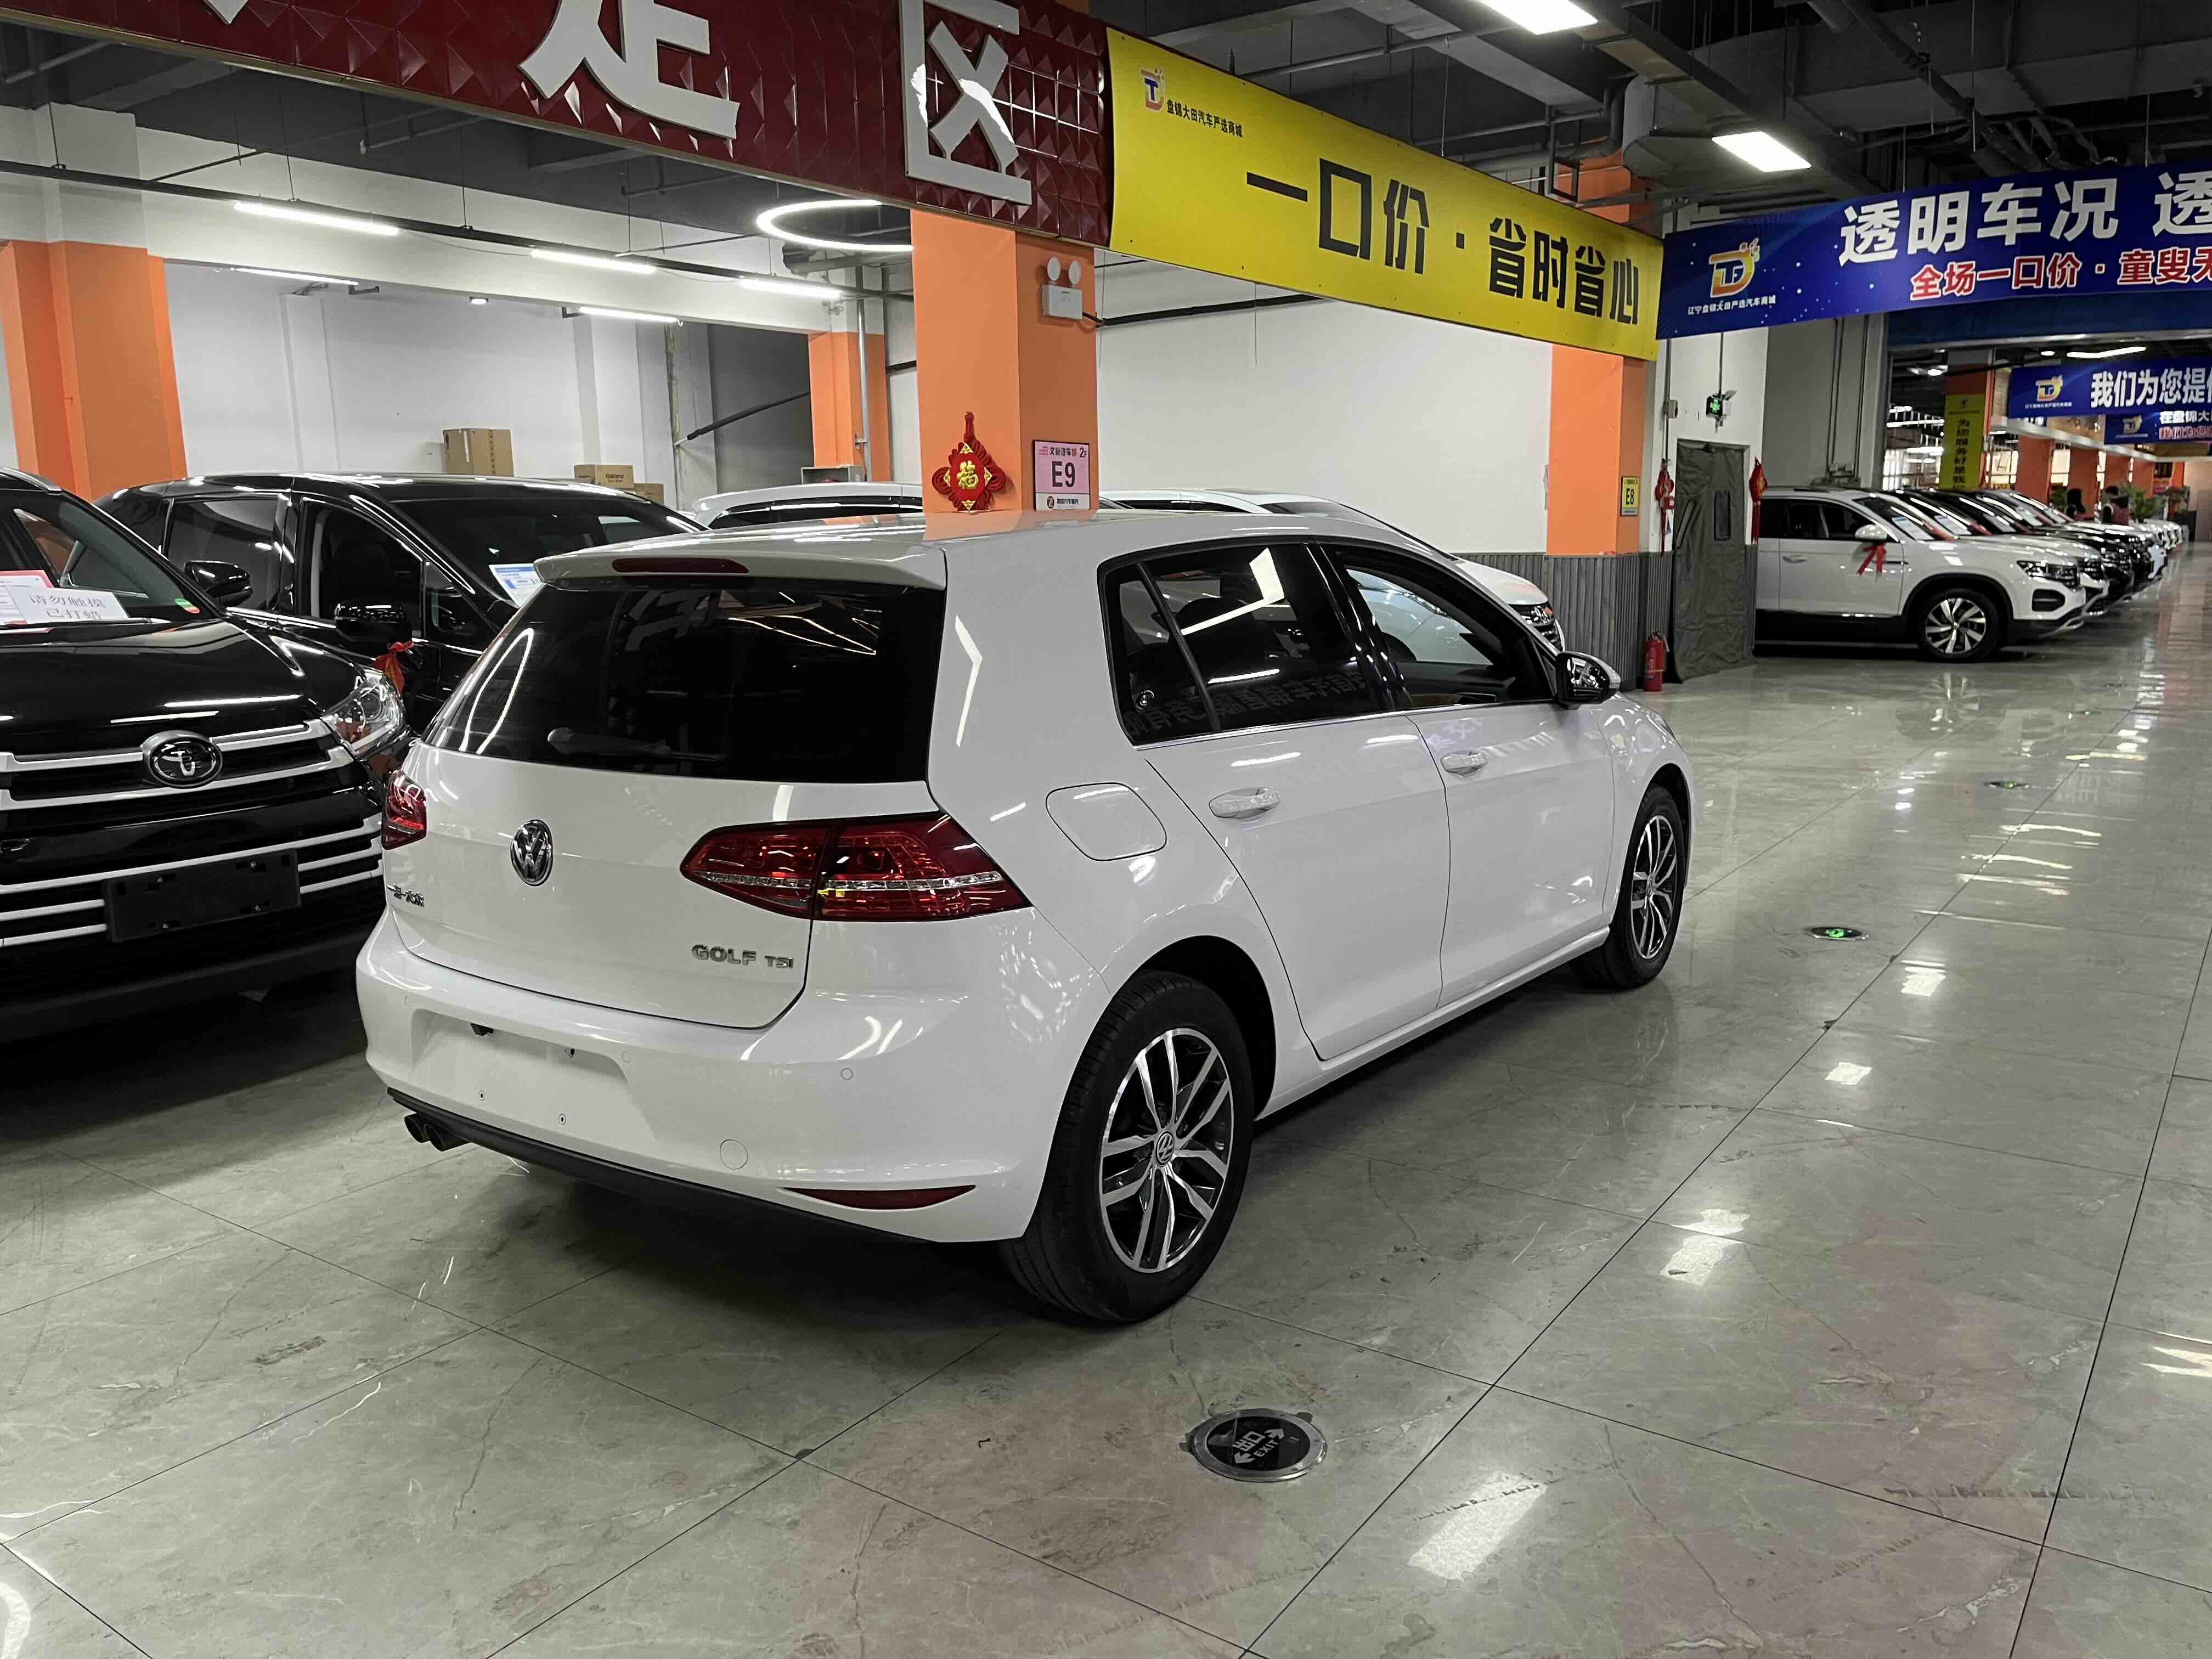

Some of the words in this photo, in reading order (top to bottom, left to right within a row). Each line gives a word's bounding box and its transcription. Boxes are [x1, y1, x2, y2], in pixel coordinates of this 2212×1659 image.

[1167, 99, 1243, 138] 盘锦大田汽车严选商城
[1839, 178, 2119, 266] 透明车况
[1247, 158, 1638, 325] 一口价·省时省心
[2090, 367, 2212, 408] 我们为您提
[2159, 410, 2212, 425] 在盘锦大
[956, 460, 979, 489] 福
[1052, 460, 1075, 488] E9
[1626, 488, 1634, 505] E8
[691, 944, 757, 966] GOLF
[764, 955, 794, 969] TSI
[1254, 1438, 1279, 1458] EXIT
